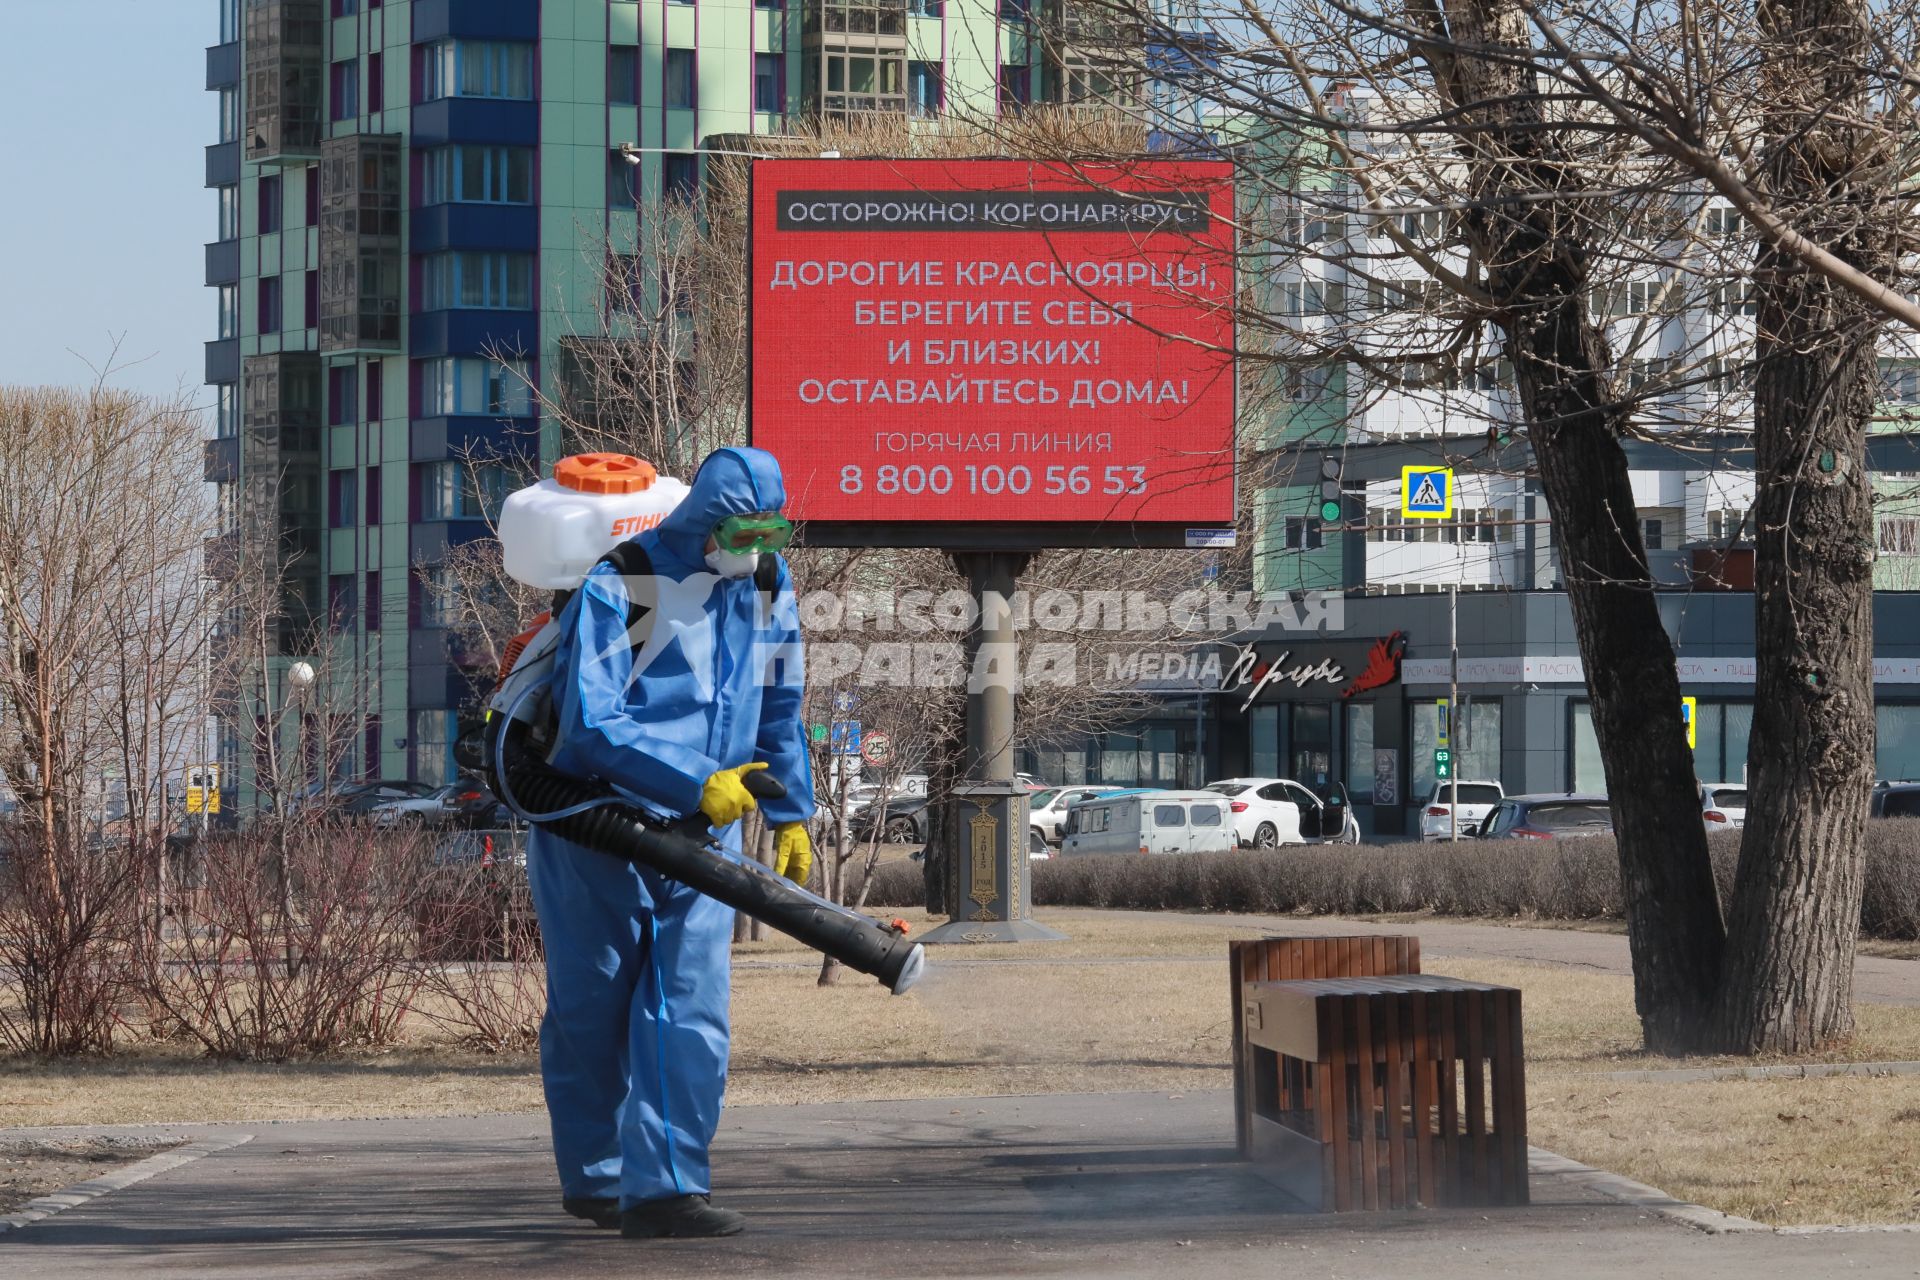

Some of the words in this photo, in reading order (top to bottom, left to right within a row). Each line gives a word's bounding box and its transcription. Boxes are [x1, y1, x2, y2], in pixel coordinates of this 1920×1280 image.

[787, 202, 977, 223] ОСТОРОЖНО!
[984, 203, 1198, 223] КОРОНАВИРУС!
[770, 260, 944, 290] ДОРОГИЕ
[956, 261, 1216, 291] КРАСНОЯРЦЫ,
[855, 300, 1032, 325] БЕРЕГИТЕ
[1042, 300, 1133, 325] СЕБЯ
[888, 339, 911, 365] И
[924, 339, 1100, 365] БЛИЗКИХ!
[798, 373, 1059, 404] ОСТАВАЙТЕСЬ
[1068, 379, 1188, 409] ДОМА!
[875, 431, 1001, 453] ГОРЯЧАЯ
[1008, 431, 1113, 453] ЛИНИЯ
[839, 464, 864, 495] 8
[876, 464, 953, 495] 800
[964, 464, 1033, 495] 100
[1044, 465, 1091, 495] 56
[1102, 465, 1147, 495] 53
[1539, 662, 1579, 676] ПАСТА
[867, 741, 885, 755] 25
[1436, 751, 1448, 761] 63
